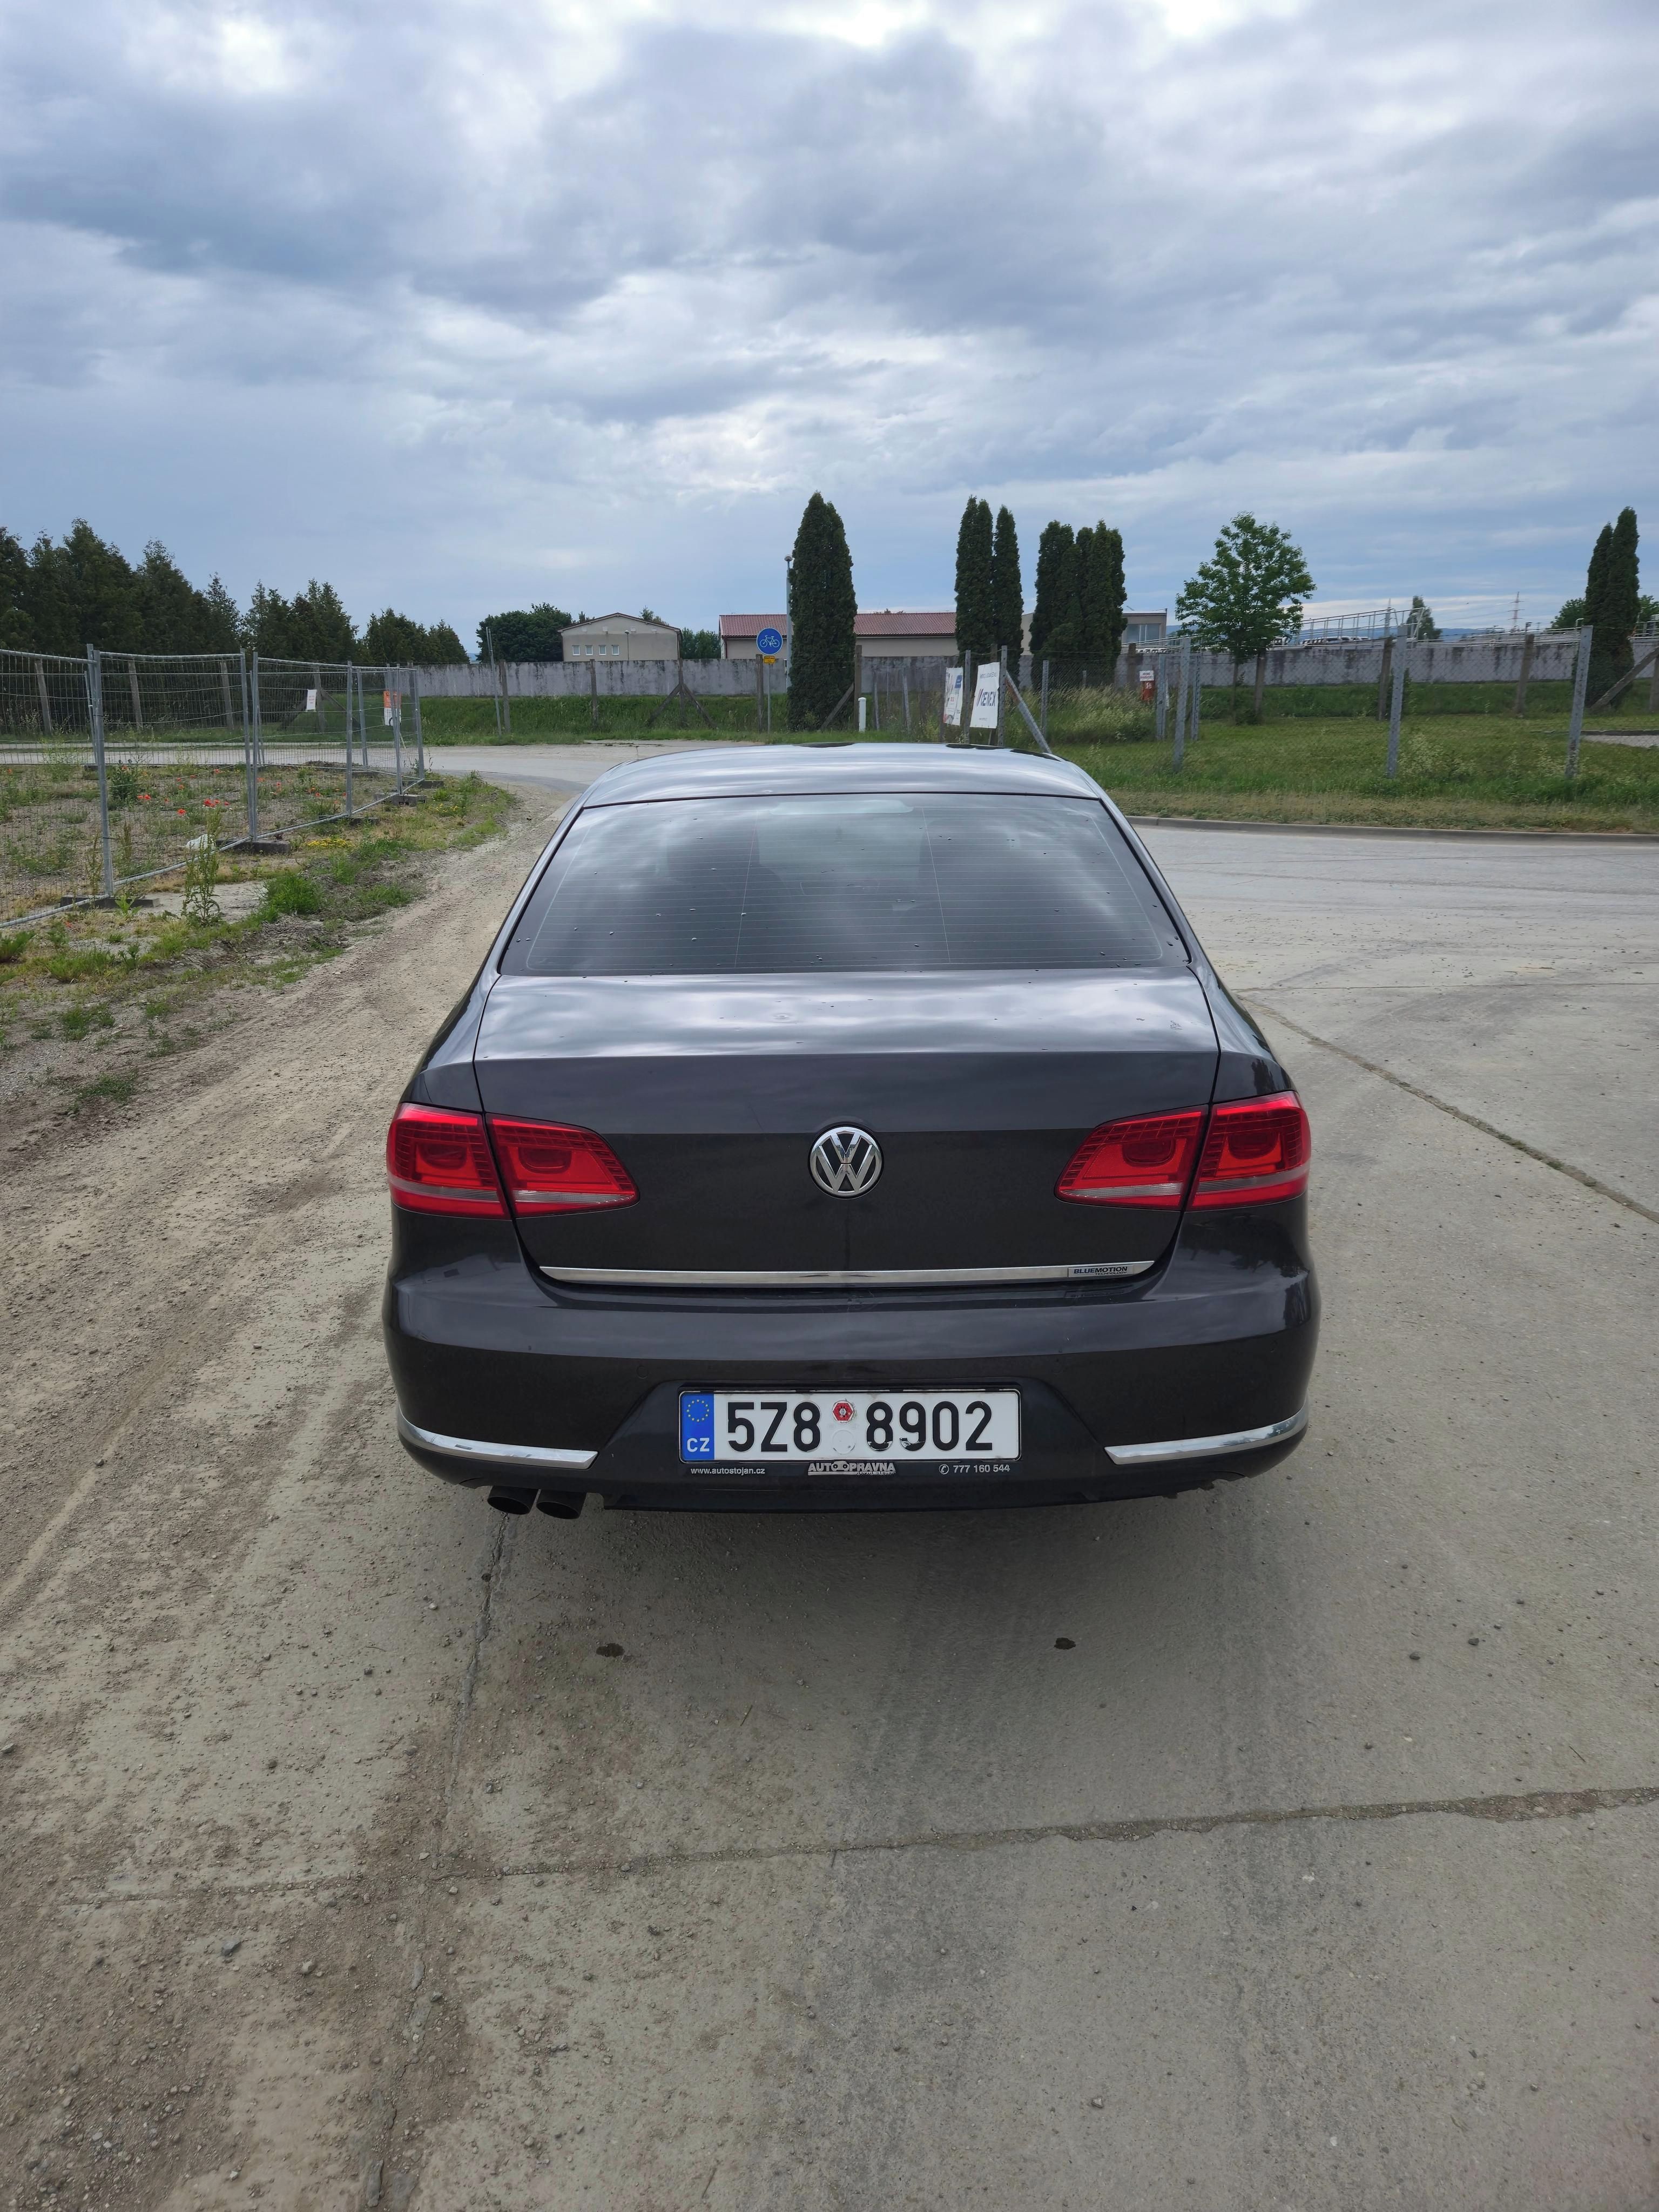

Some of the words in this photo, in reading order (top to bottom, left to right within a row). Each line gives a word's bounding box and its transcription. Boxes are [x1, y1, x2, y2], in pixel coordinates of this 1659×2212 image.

[727, 1401, 821, 1452] 5Z8
[866, 1401, 993, 1452] 8902
[687, 1438, 710, 1452] CZ
[691, 1467, 765, 1476] www.autostojan.cz
[953, 1465, 970, 1473] 777
[974, 1465, 990, 1473] 160
[993, 1464, 1010, 1473] 544
